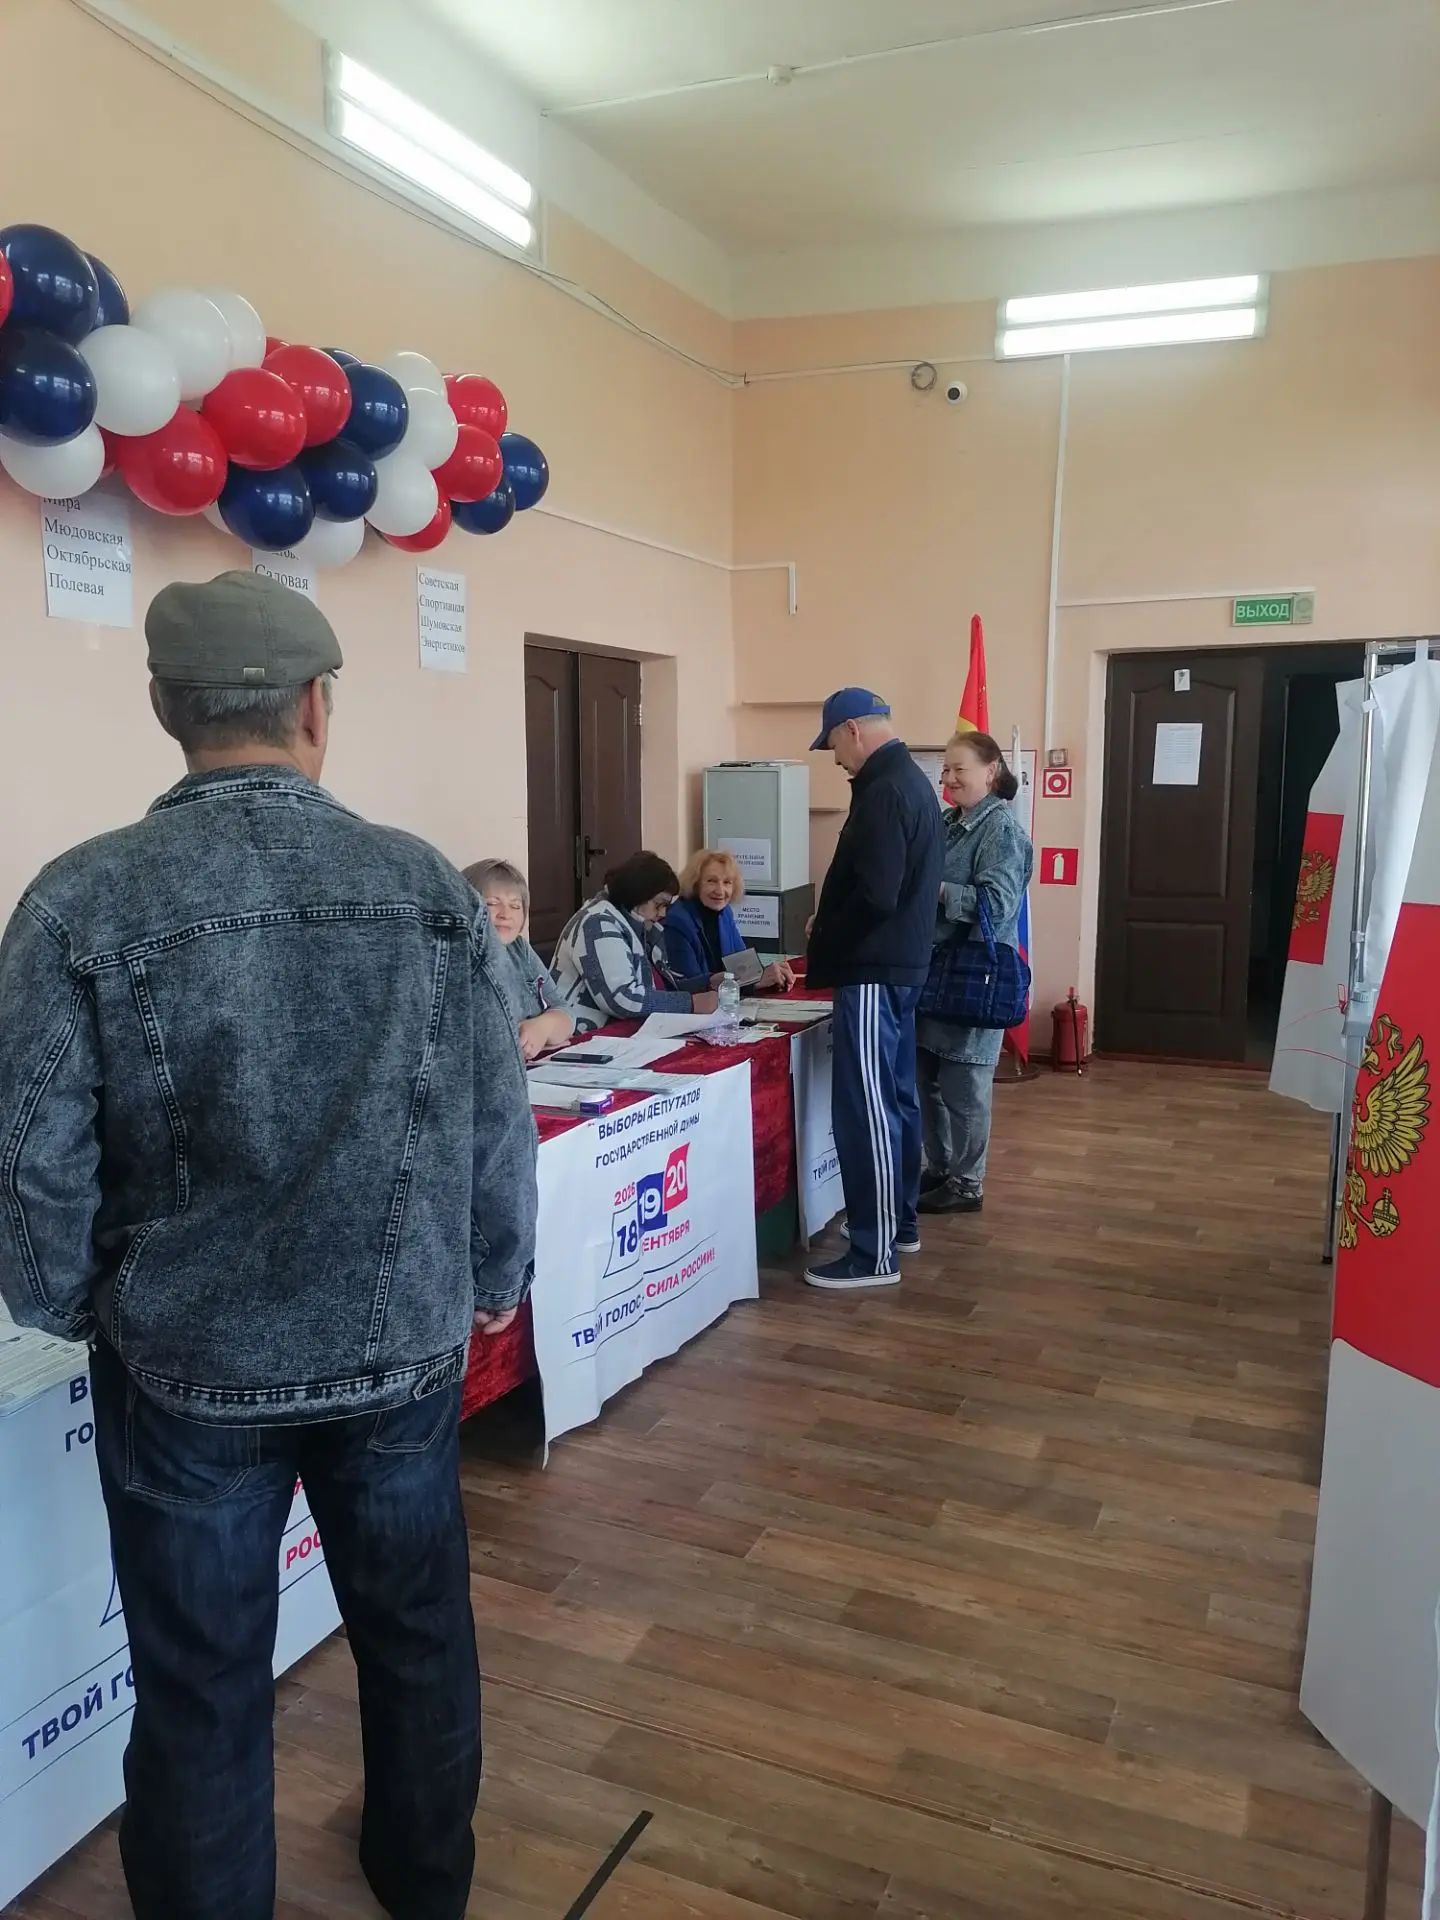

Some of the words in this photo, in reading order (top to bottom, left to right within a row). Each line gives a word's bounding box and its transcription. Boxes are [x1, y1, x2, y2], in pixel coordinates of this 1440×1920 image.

[44, 516, 124, 546] Мюдовская
[46, 543, 132, 574] Октябрьская
[48, 571, 105, 596] Полевая
[418, 572, 459, 592] Советская
[419, 594, 465, 614] Спортивная
[1236, 603, 1290, 619] ВЫХОД
[598, 1108, 646, 1140] ВЫБОРЫ
[646, 1087, 701, 1122] ДЕПУТАТОВ
[595, 1119, 679, 1169] ГОСУДАРСТВЕННОЙ
[665, 1159, 687, 1199] 20
[639, 1187, 662, 1225] 19
[616, 1219, 638, 1257] 18
[640, 1219, 690, 1256] ЕНТЯБРЯ
[646, 1273, 680, 1298] СИЛА
[681, 1247, 716, 1283] РОССИИ!
[21, 1682, 103, 1760] ТВОЙ
